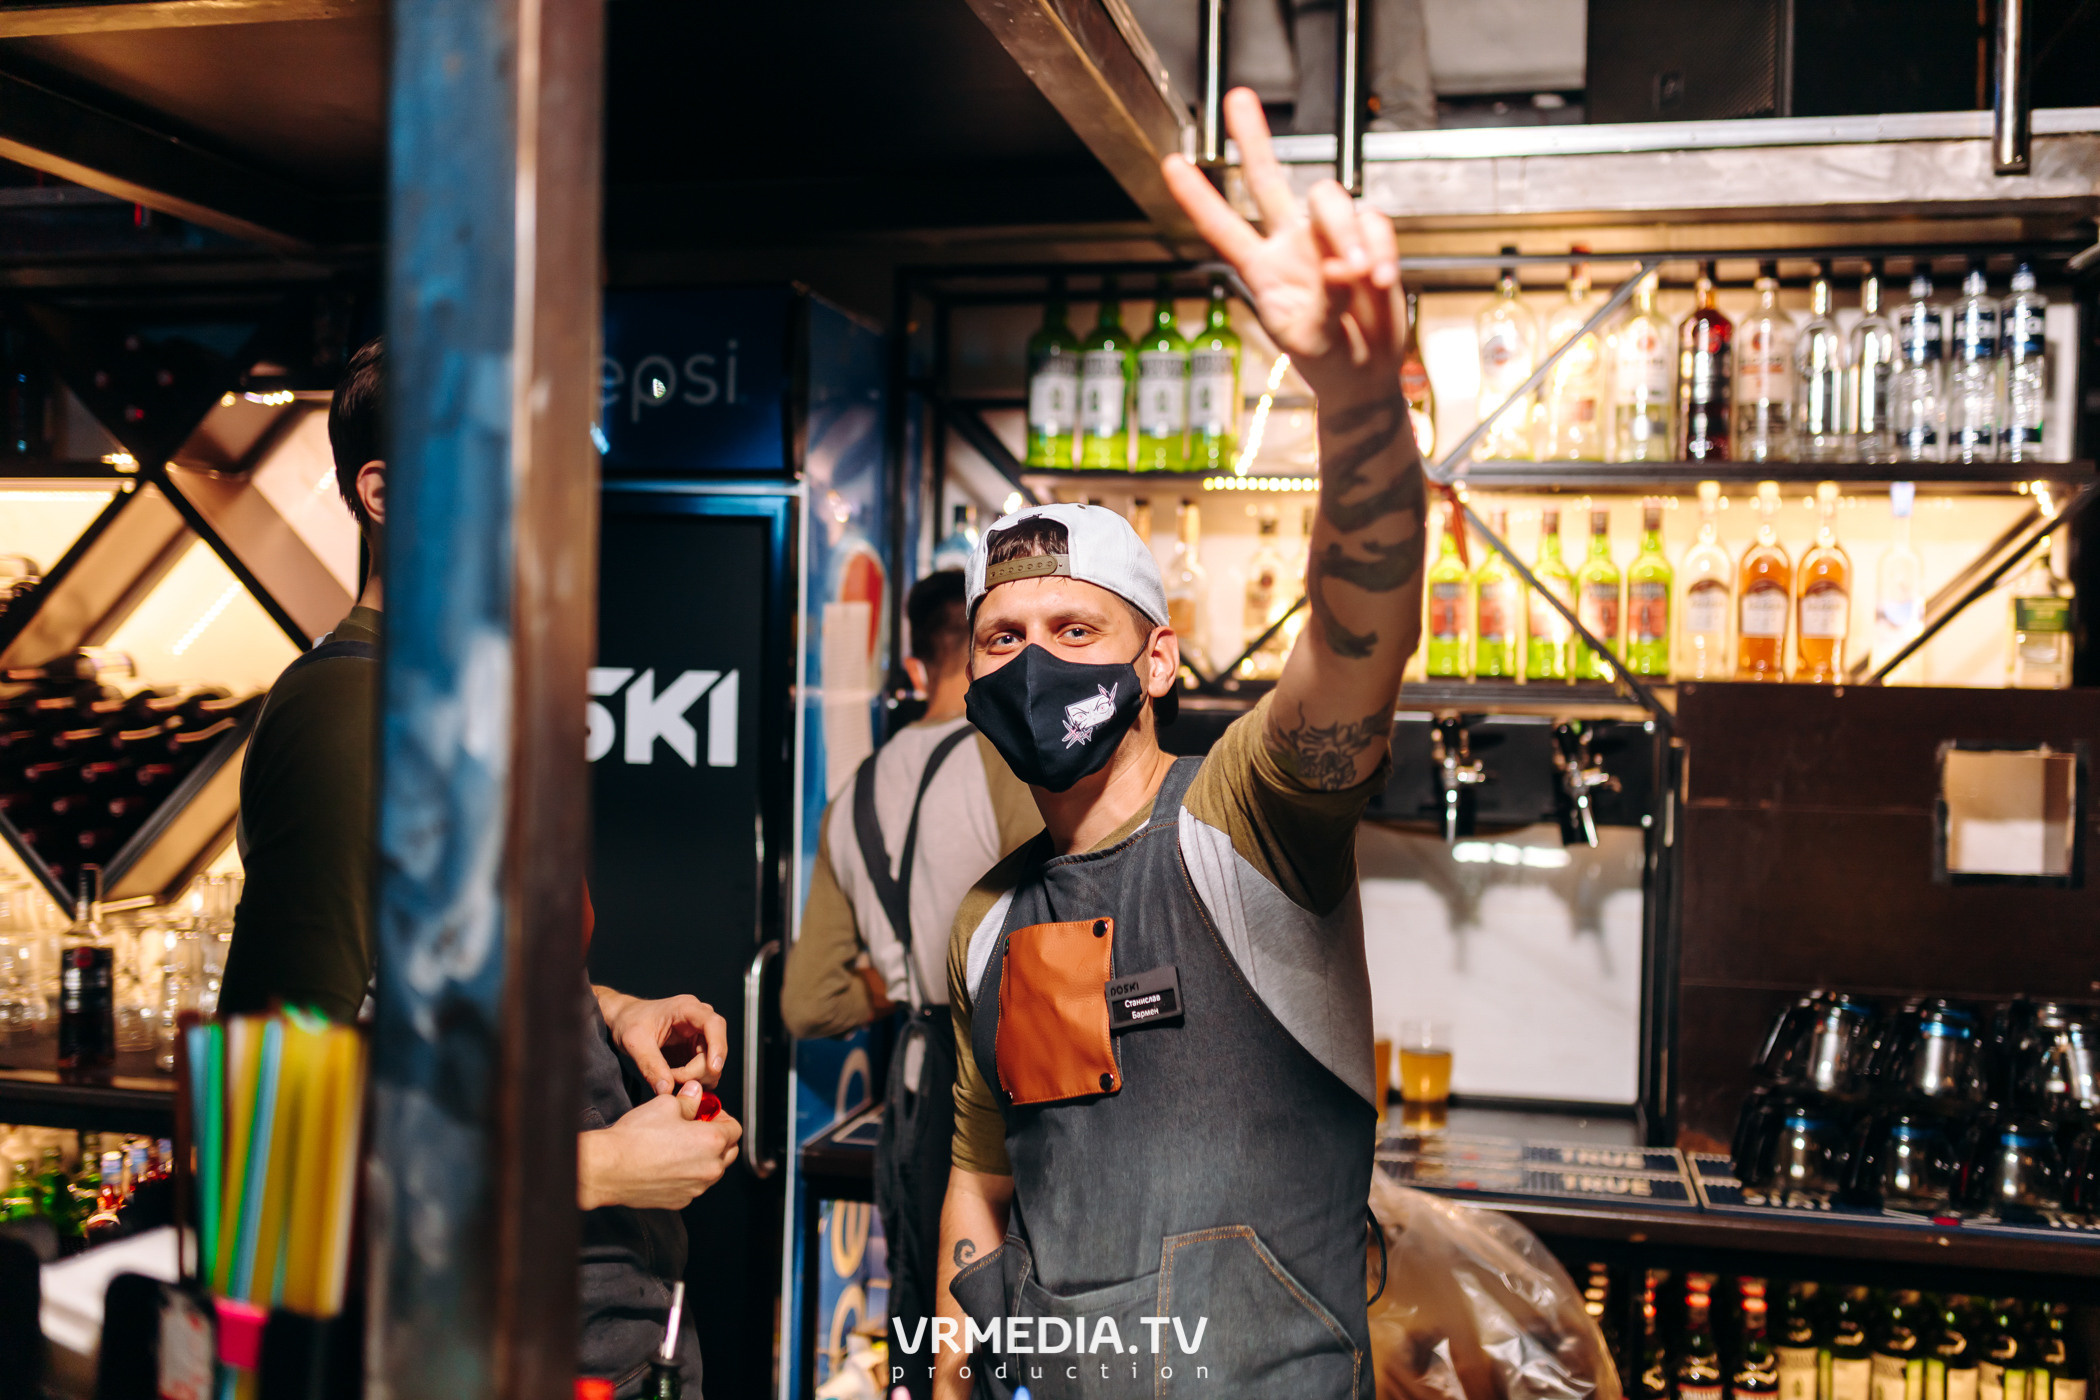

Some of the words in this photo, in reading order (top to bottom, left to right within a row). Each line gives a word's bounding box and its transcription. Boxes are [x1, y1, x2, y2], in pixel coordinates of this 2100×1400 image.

[1110, 982, 1140, 997] DOSKI
[1124, 994, 1161, 1009] Станислав
[1131, 1007, 1159, 1020] Бармен
